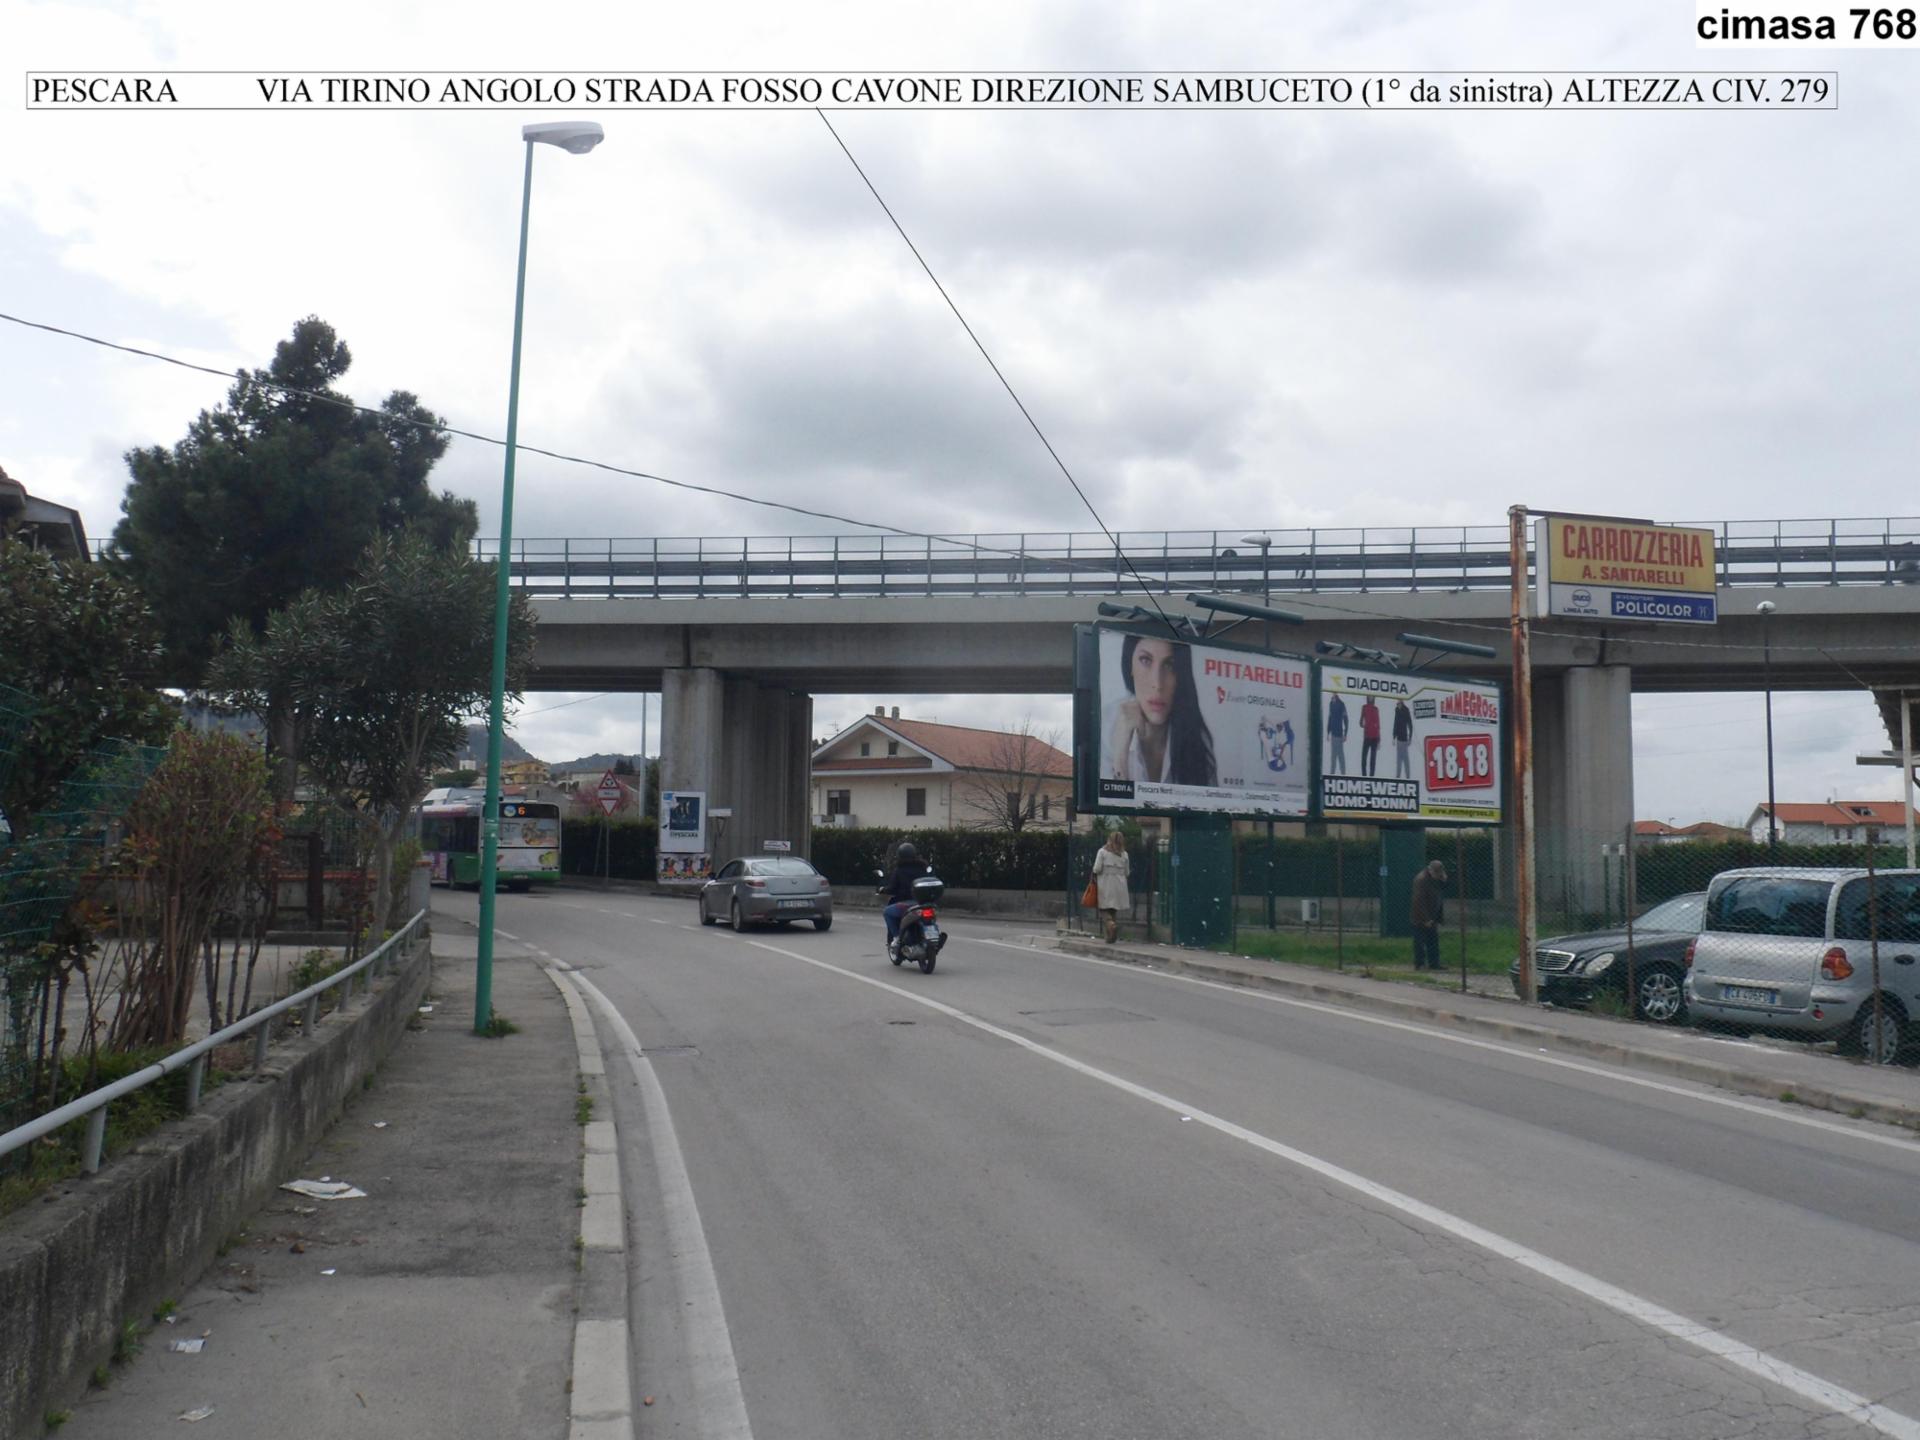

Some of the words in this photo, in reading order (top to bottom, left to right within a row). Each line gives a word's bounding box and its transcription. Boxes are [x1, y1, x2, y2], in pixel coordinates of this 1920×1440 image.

[1562, 524, 1704, 568] CARROZZERIA
[1582, 565, 1597, 580] A.
[1600, 566, 1685, 585] SANTARELLI
[1615, 601, 1692, 617] POLICOLOR
[1204, 659, 1304, 689] PITTARELLO
[1346, 676, 1409, 694] DIADORA
[1440, 690, 1498, 719] EMMEGROSS
[1432, 743, 1489, 782] 18,18
[1324, 778, 1417, 797] HOMEWEAR
[518, 806, 527, 816] 6
[1325, 794, 1417, 810] UOMO-DONNA
